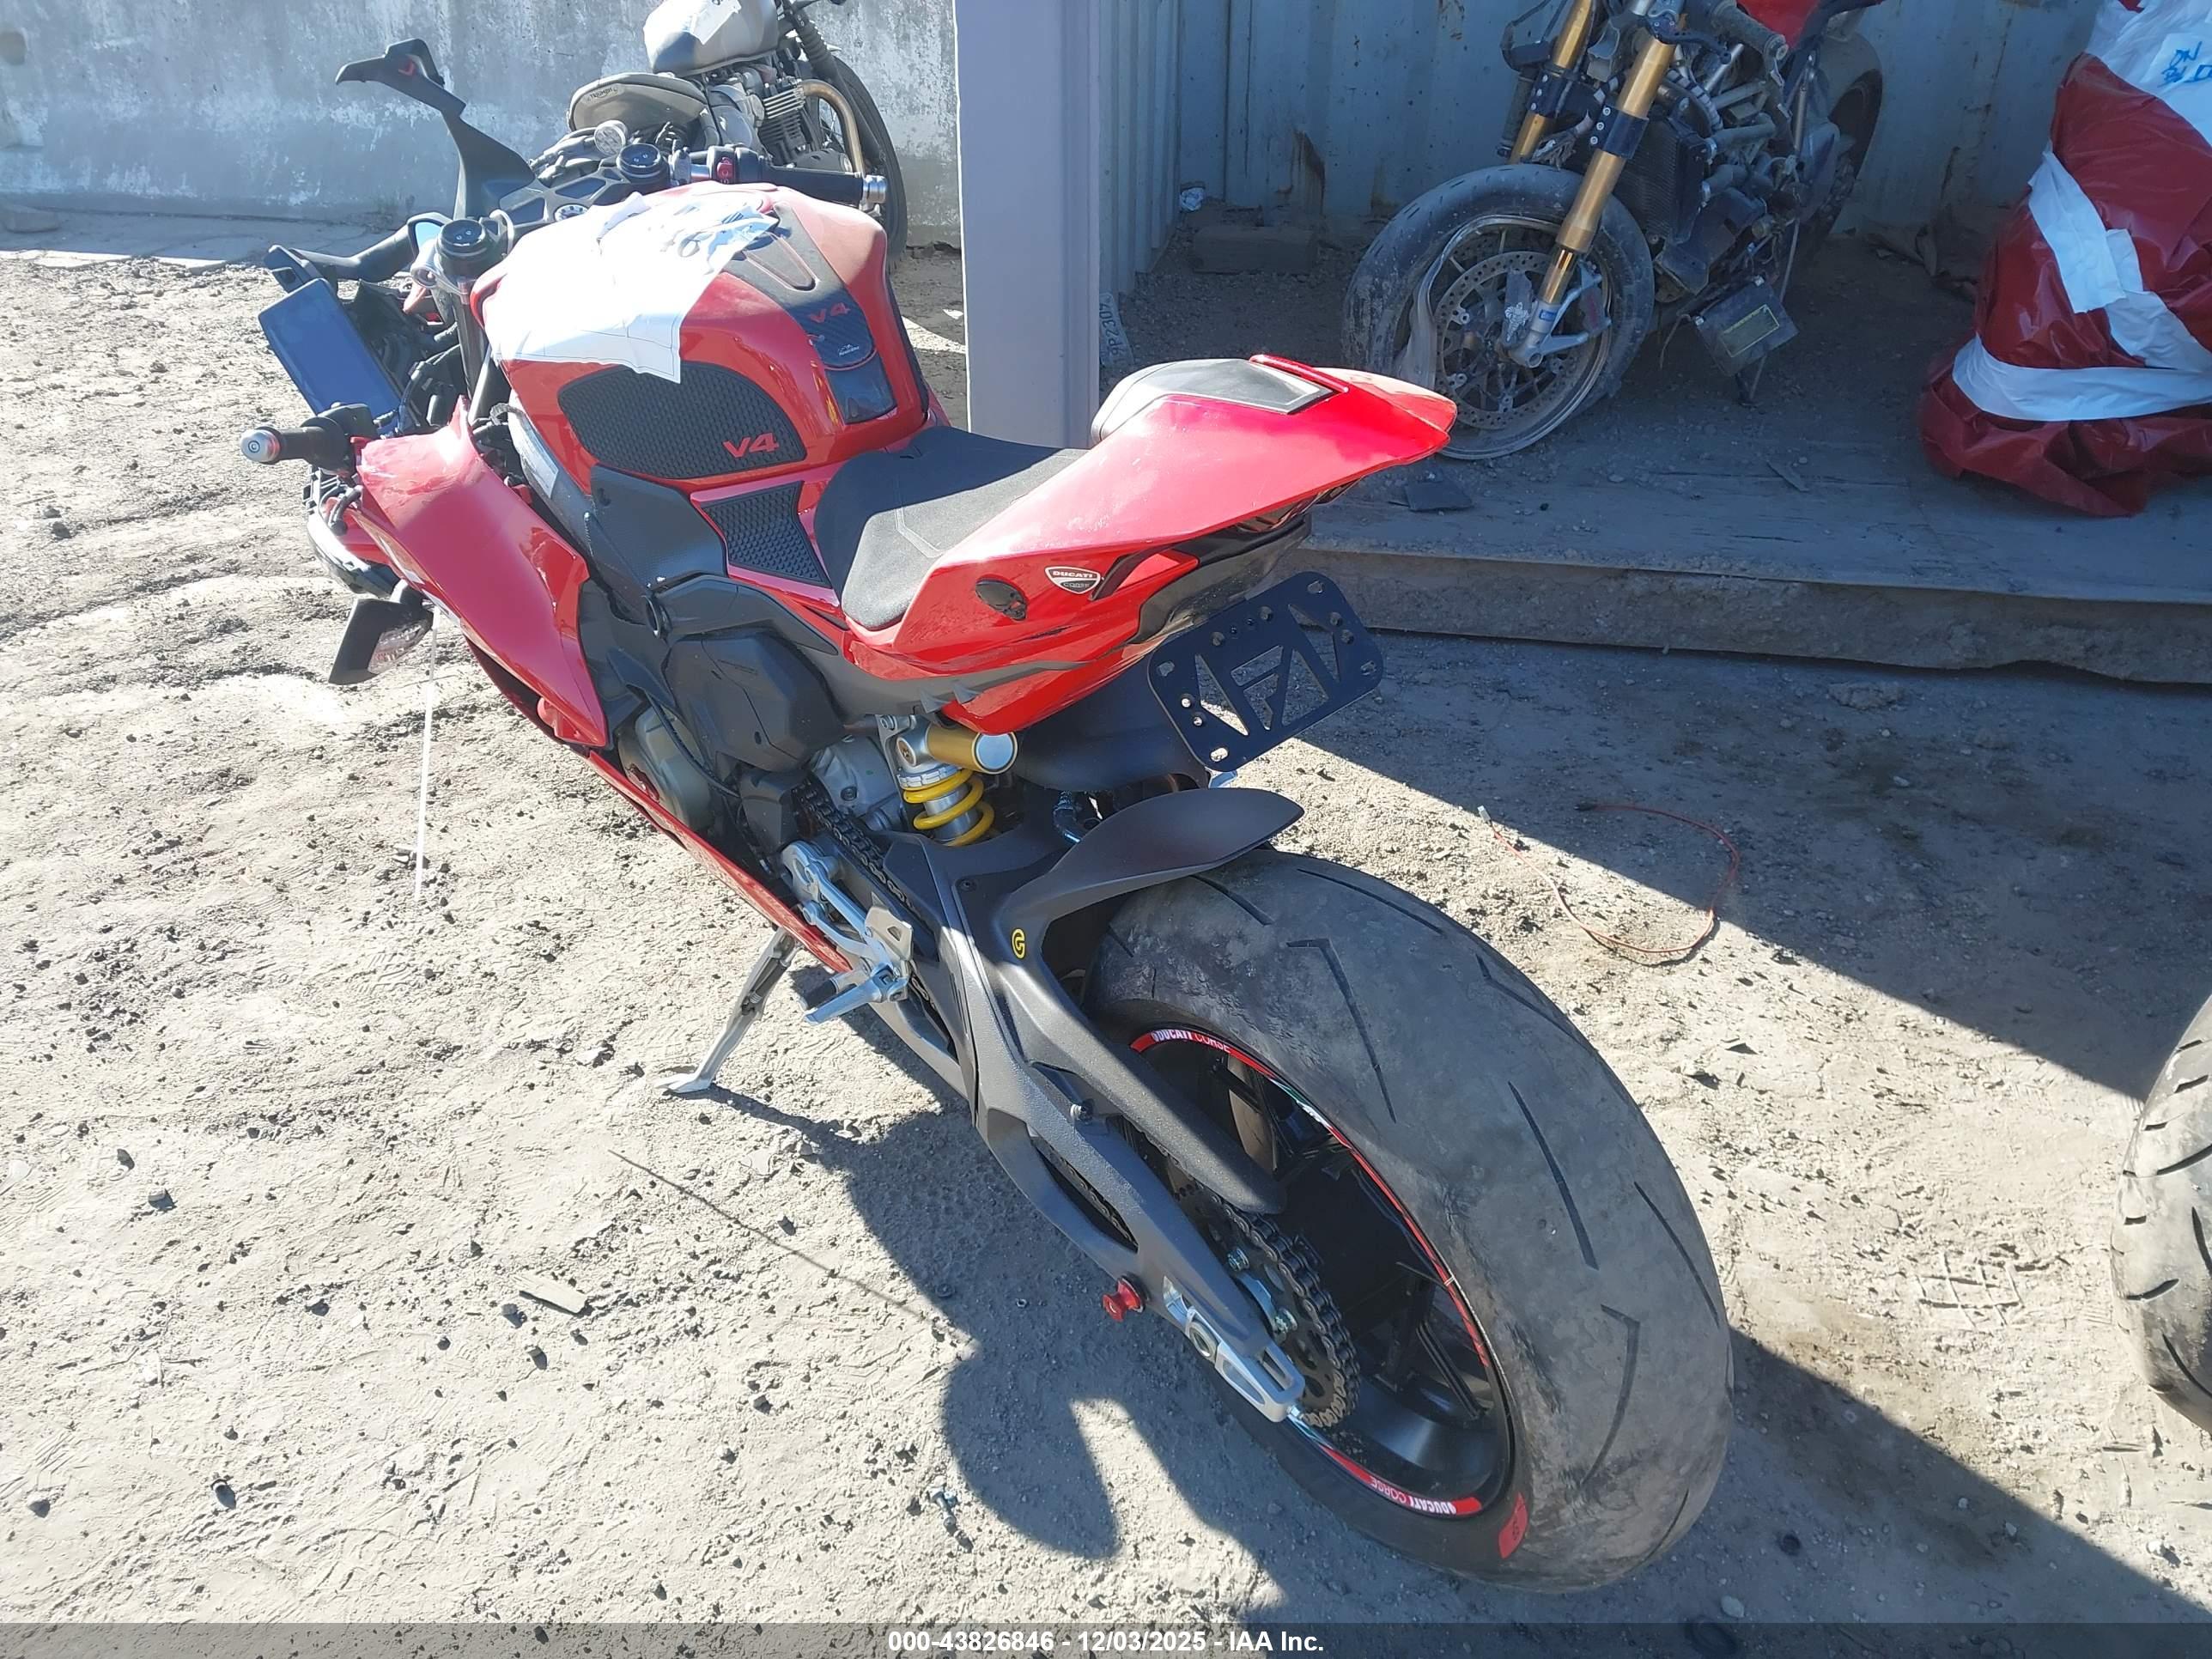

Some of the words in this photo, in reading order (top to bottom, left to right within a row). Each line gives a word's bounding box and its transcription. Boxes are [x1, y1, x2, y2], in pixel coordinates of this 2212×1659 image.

[808, 301, 851, 323] V4
[722, 432, 780, 458] V4
[1158, 1029, 1193, 1041] DUCATI
[1370, 1475, 1407, 1504] CORSE
[1409, 1495, 1450, 1514] DUCATI
